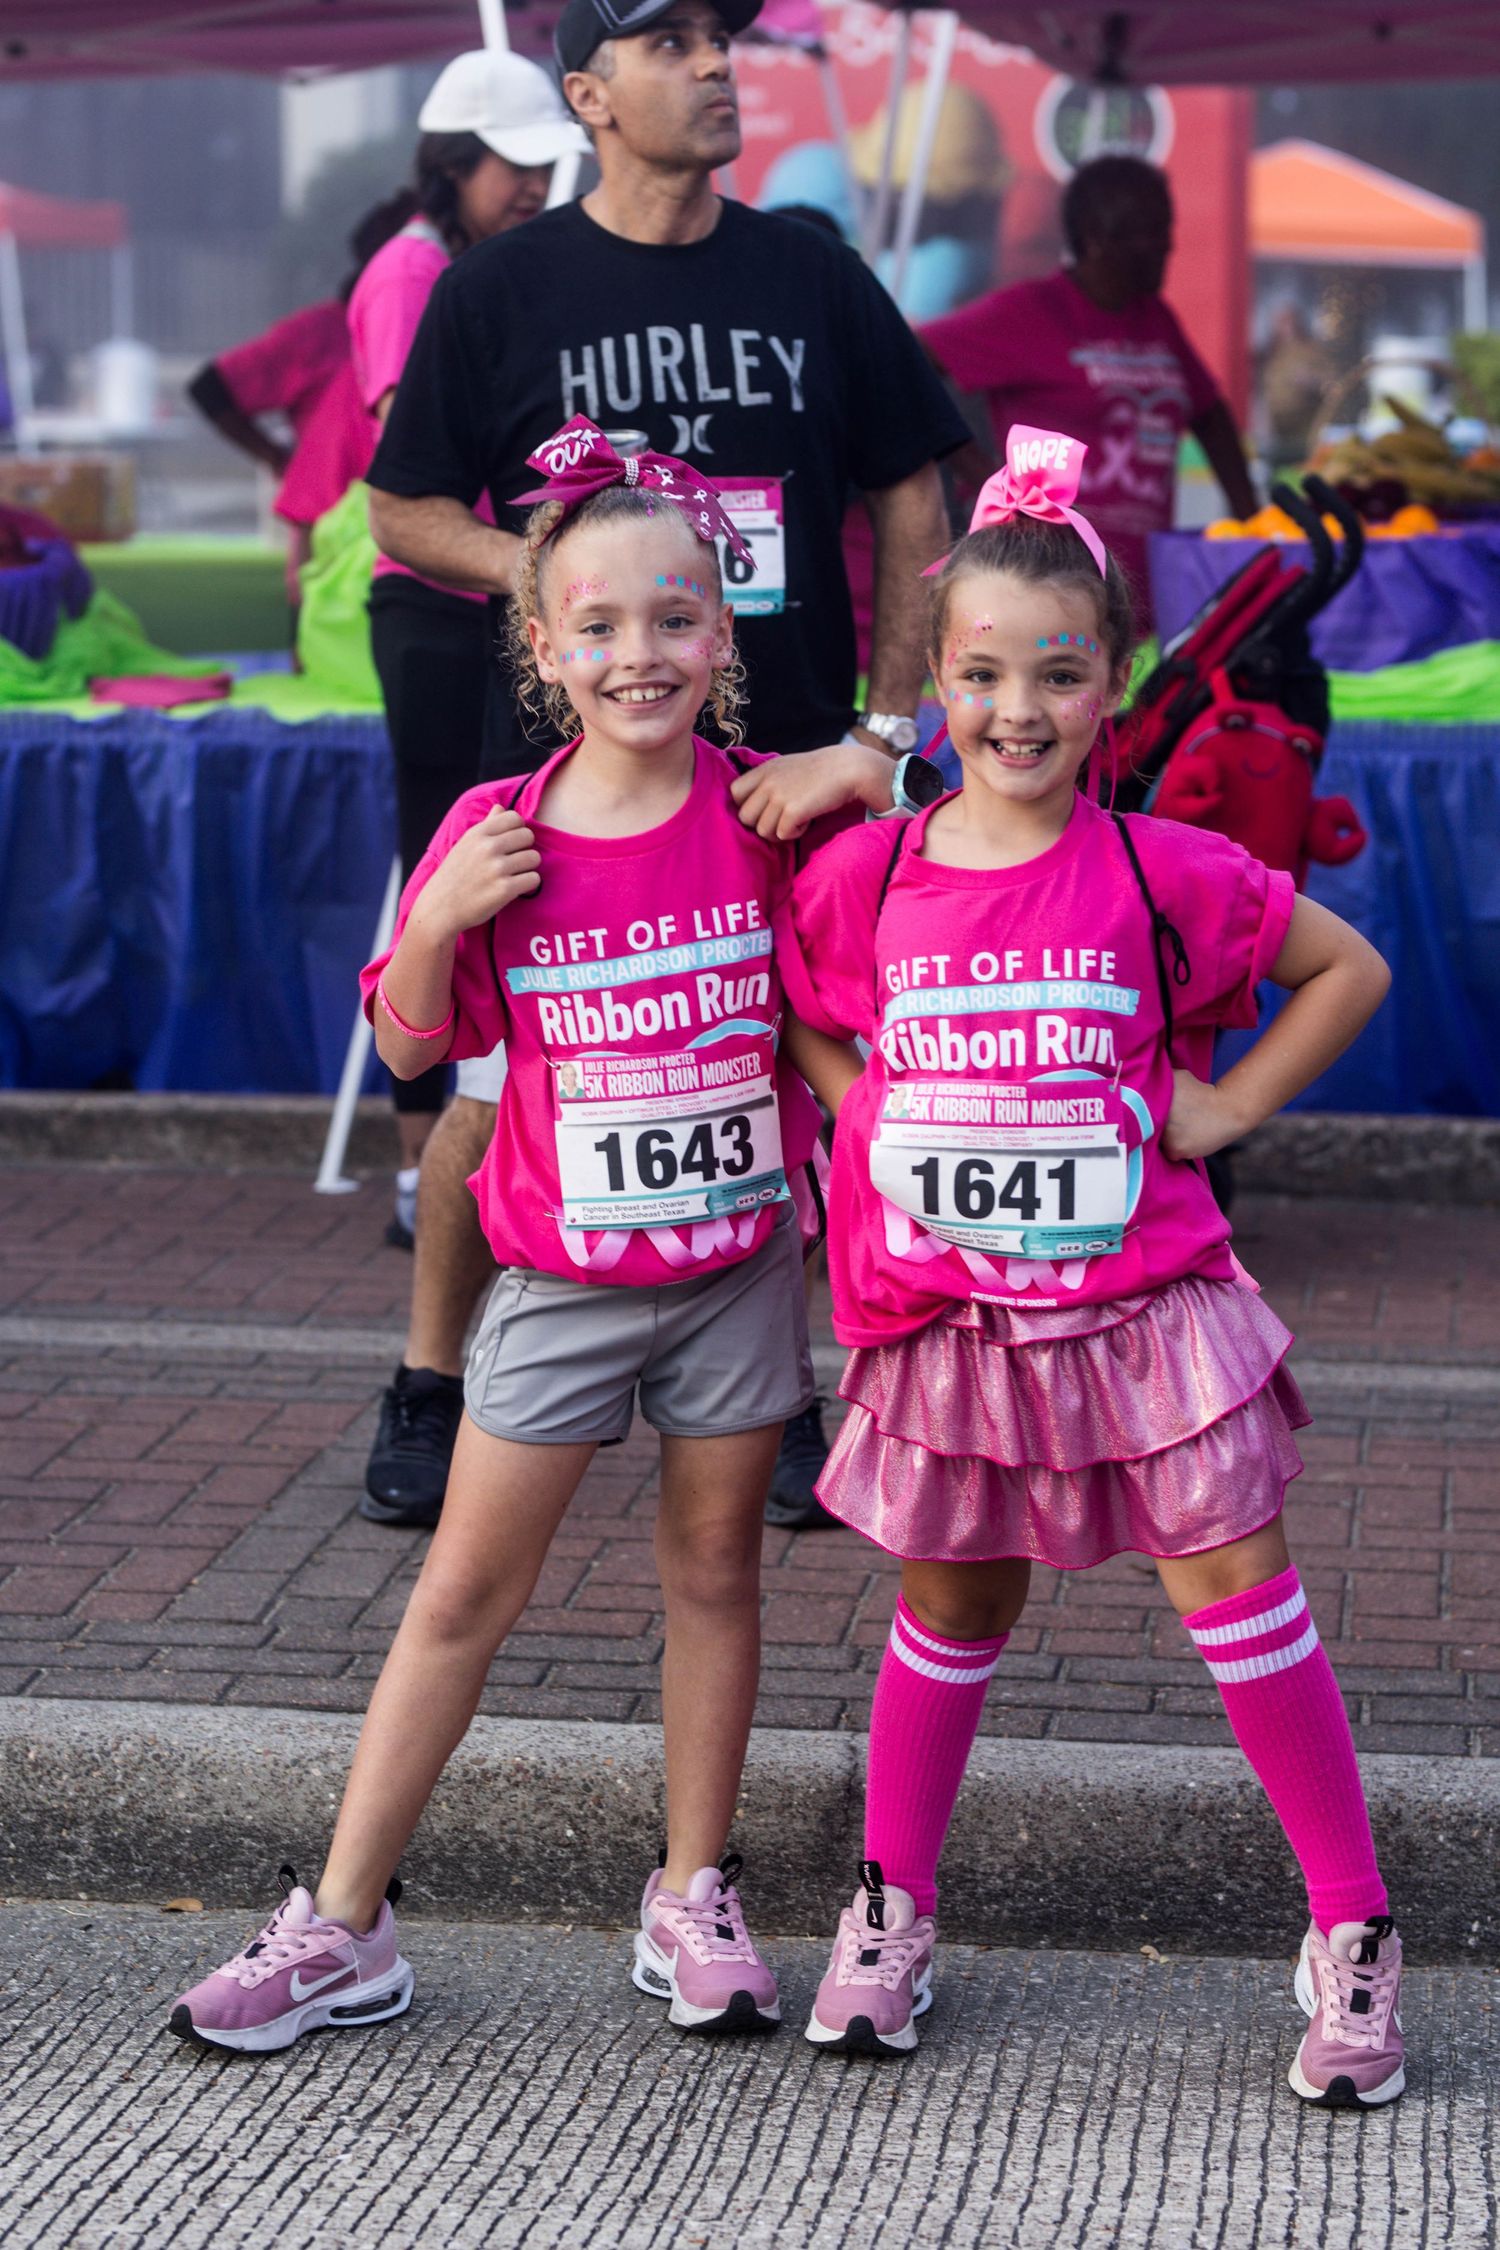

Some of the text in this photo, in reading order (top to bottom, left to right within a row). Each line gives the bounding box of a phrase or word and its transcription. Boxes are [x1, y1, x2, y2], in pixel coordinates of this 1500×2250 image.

[560, 323, 805, 420] HURLEY
[1012, 438, 1074, 477] HOPE
[529, 899, 761, 965] GIFT OF LIFE
[520, 967, 564, 989] JULIE
[565, 946, 698, 988] RICHARDSON
[885, 948, 1116, 994] GIFT OF LIFE
[537, 971, 770, 1046] Ribbon Run
[905, 983, 1041, 1014] RICHARDSON
[1046, 983, 1130, 1012] PROCTER
[584, 1052, 696, 1074] JULIE RICHARDSON PROCTER
[879, 1014, 1117, 1073] Ribbon Run
[584, 1051, 762, 1099] 5K RIBBON RUN MONSTER
[988, 1085, 1027, 1099] PROCTER
[909, 1096, 1106, 1125] 5K RIBBON RUN MONSTER
[594, 1114, 754, 1192] 1643
[582, 1199, 690, 1214] Fighting Breast and Ovarian
[911, 1156, 1076, 1221] 1641
[583, 1212, 610, 1221] Cancer
[621, 1209, 662, 1219] Southeast
[662, 1207, 686, 1217] Texas
[955, 1229, 970, 1238] and
[972, 1231, 1004, 1240] Ovarian
[976, 1238, 999, 1247] Texas
[1016, 1298, 1058, 1307] SPONSORS
